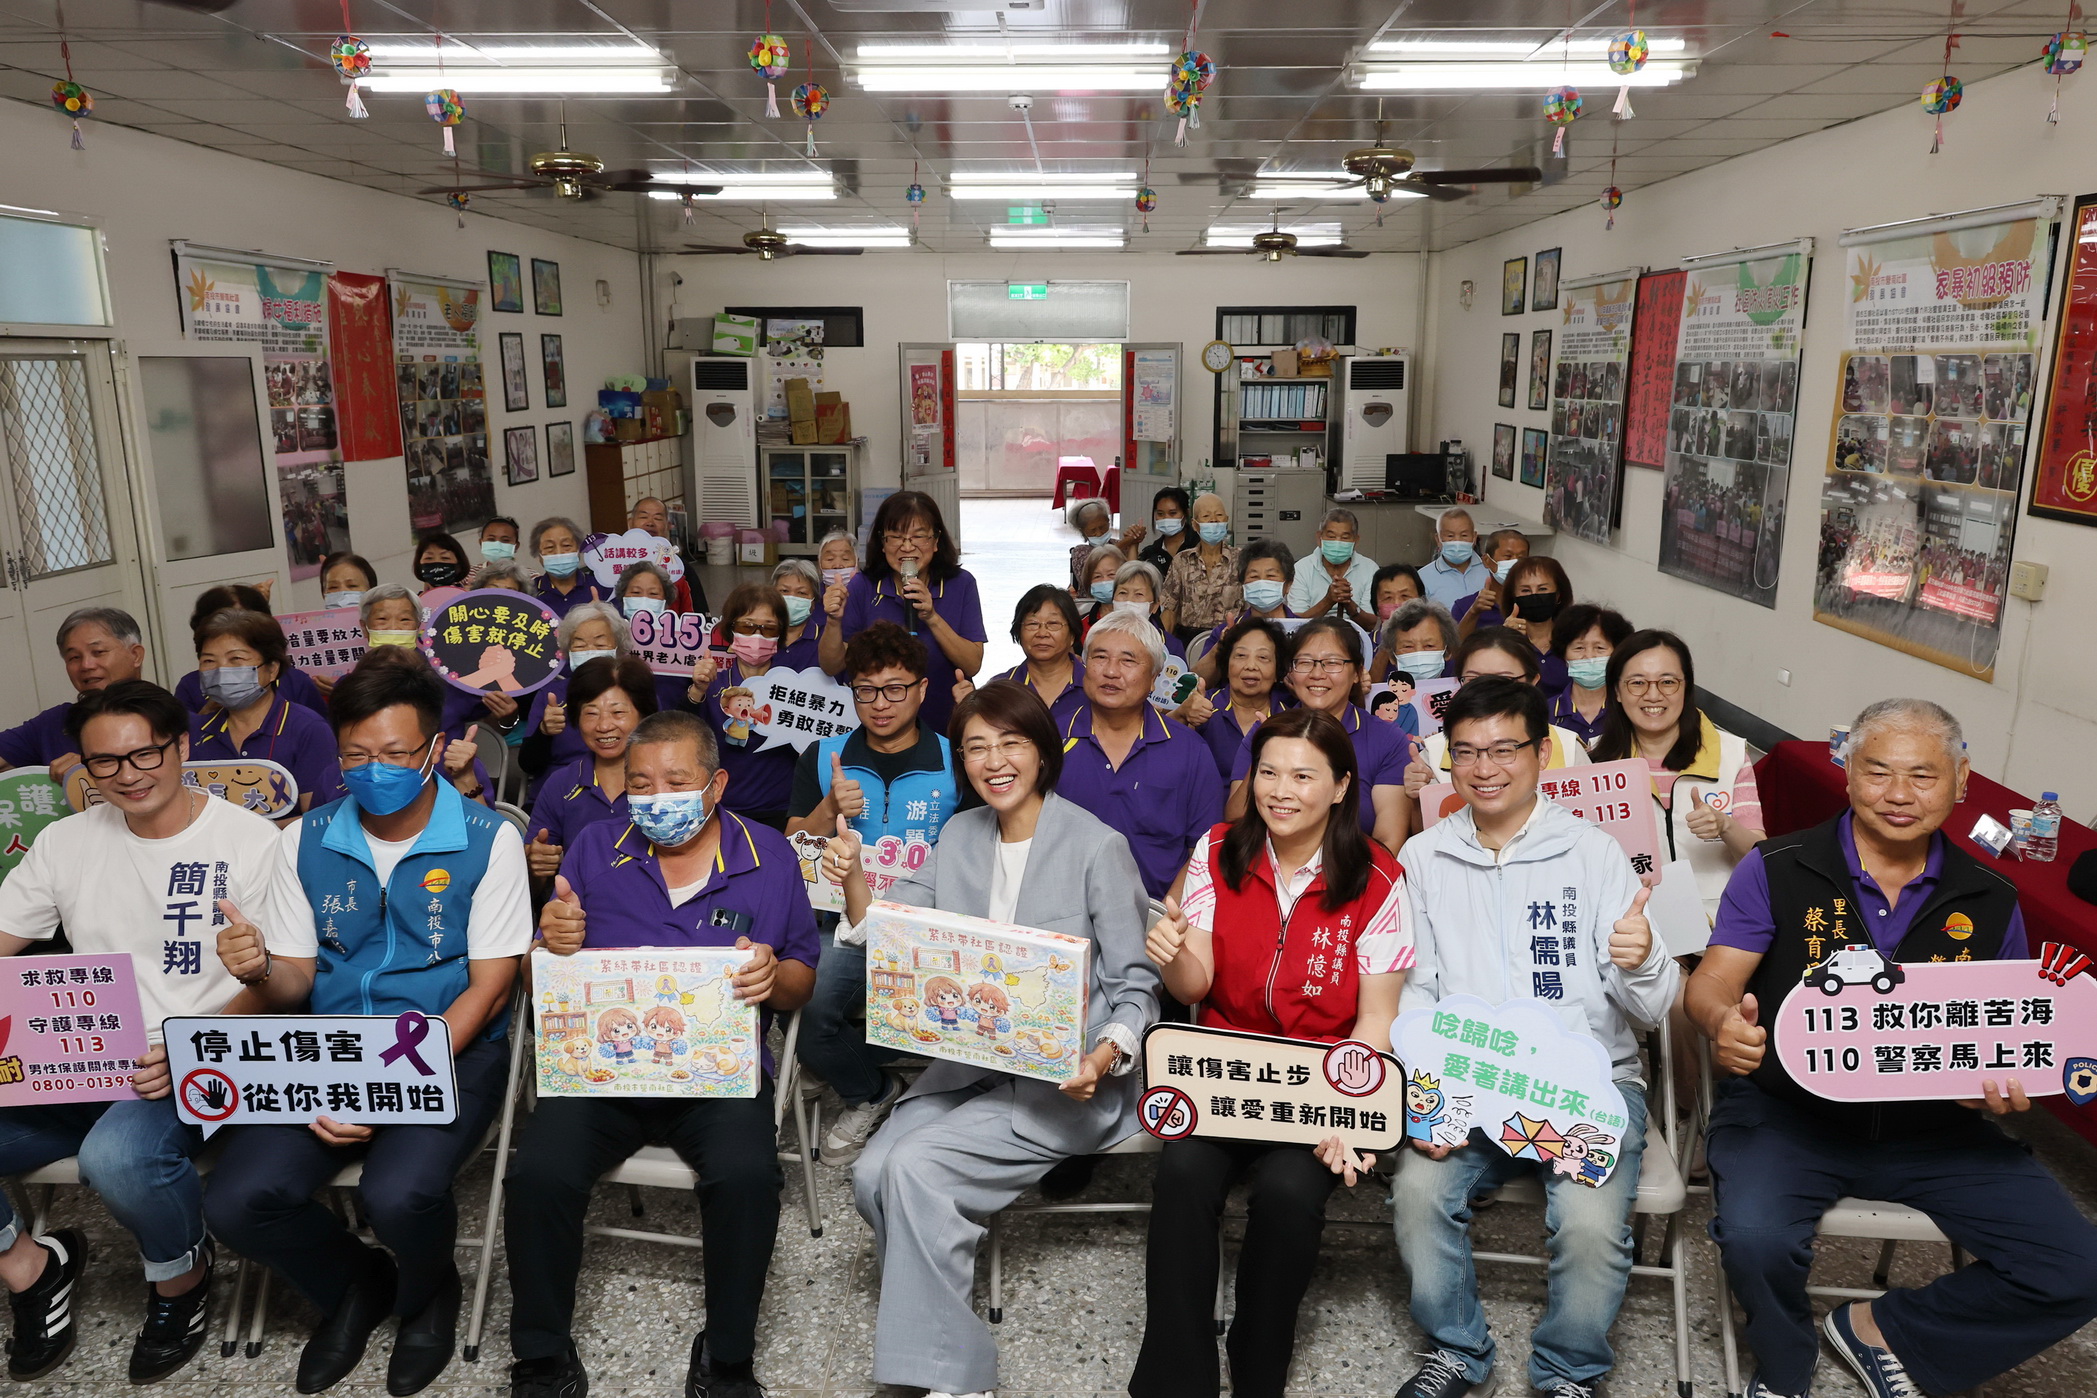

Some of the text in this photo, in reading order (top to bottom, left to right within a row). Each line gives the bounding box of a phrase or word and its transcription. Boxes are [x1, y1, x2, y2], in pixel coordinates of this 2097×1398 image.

[585, 534, 597, 545] 113
[449, 604, 551, 641] 關心要及時
[631, 610, 703, 651] 615
[443, 625, 546, 660] 傷害就停止
[769, 684, 846, 717] 拒絕暴力
[1591, 771, 1628, 793] 110
[928, 800, 941, 844] 立法委
[1594, 802, 1632, 823] 113
[344, 878, 359, 913] 市長
[163, 861, 210, 975] 簡千翔
[320, 894, 346, 954] 張嘉
[1562, 886, 1577, 968] 南投縣議員
[1831, 897, 1850, 940] 里長
[1301, 926, 1334, 998] 林憶如
[1329, 913, 1352, 986] 南投縣議員
[20, 966, 116, 988] 求救專線
[50, 989, 97, 1009] 110
[1803, 997, 2055, 1033] 113 救你離苦海
[27, 1013, 122, 1034] 守護專線
[59, 1035, 106, 1055] 113
[190, 1029, 364, 1064] 停止傷害
[1805, 1040, 2056, 1075] 110 警察馬上來
[1167, 1054, 1311, 1086] 讓傷害止步
[1441, 1052, 1590, 1118] 愛著講出來
[242, 1082, 445, 1114] 從你我開始
[1210, 1096, 1387, 1133] 讓愛重新開始
